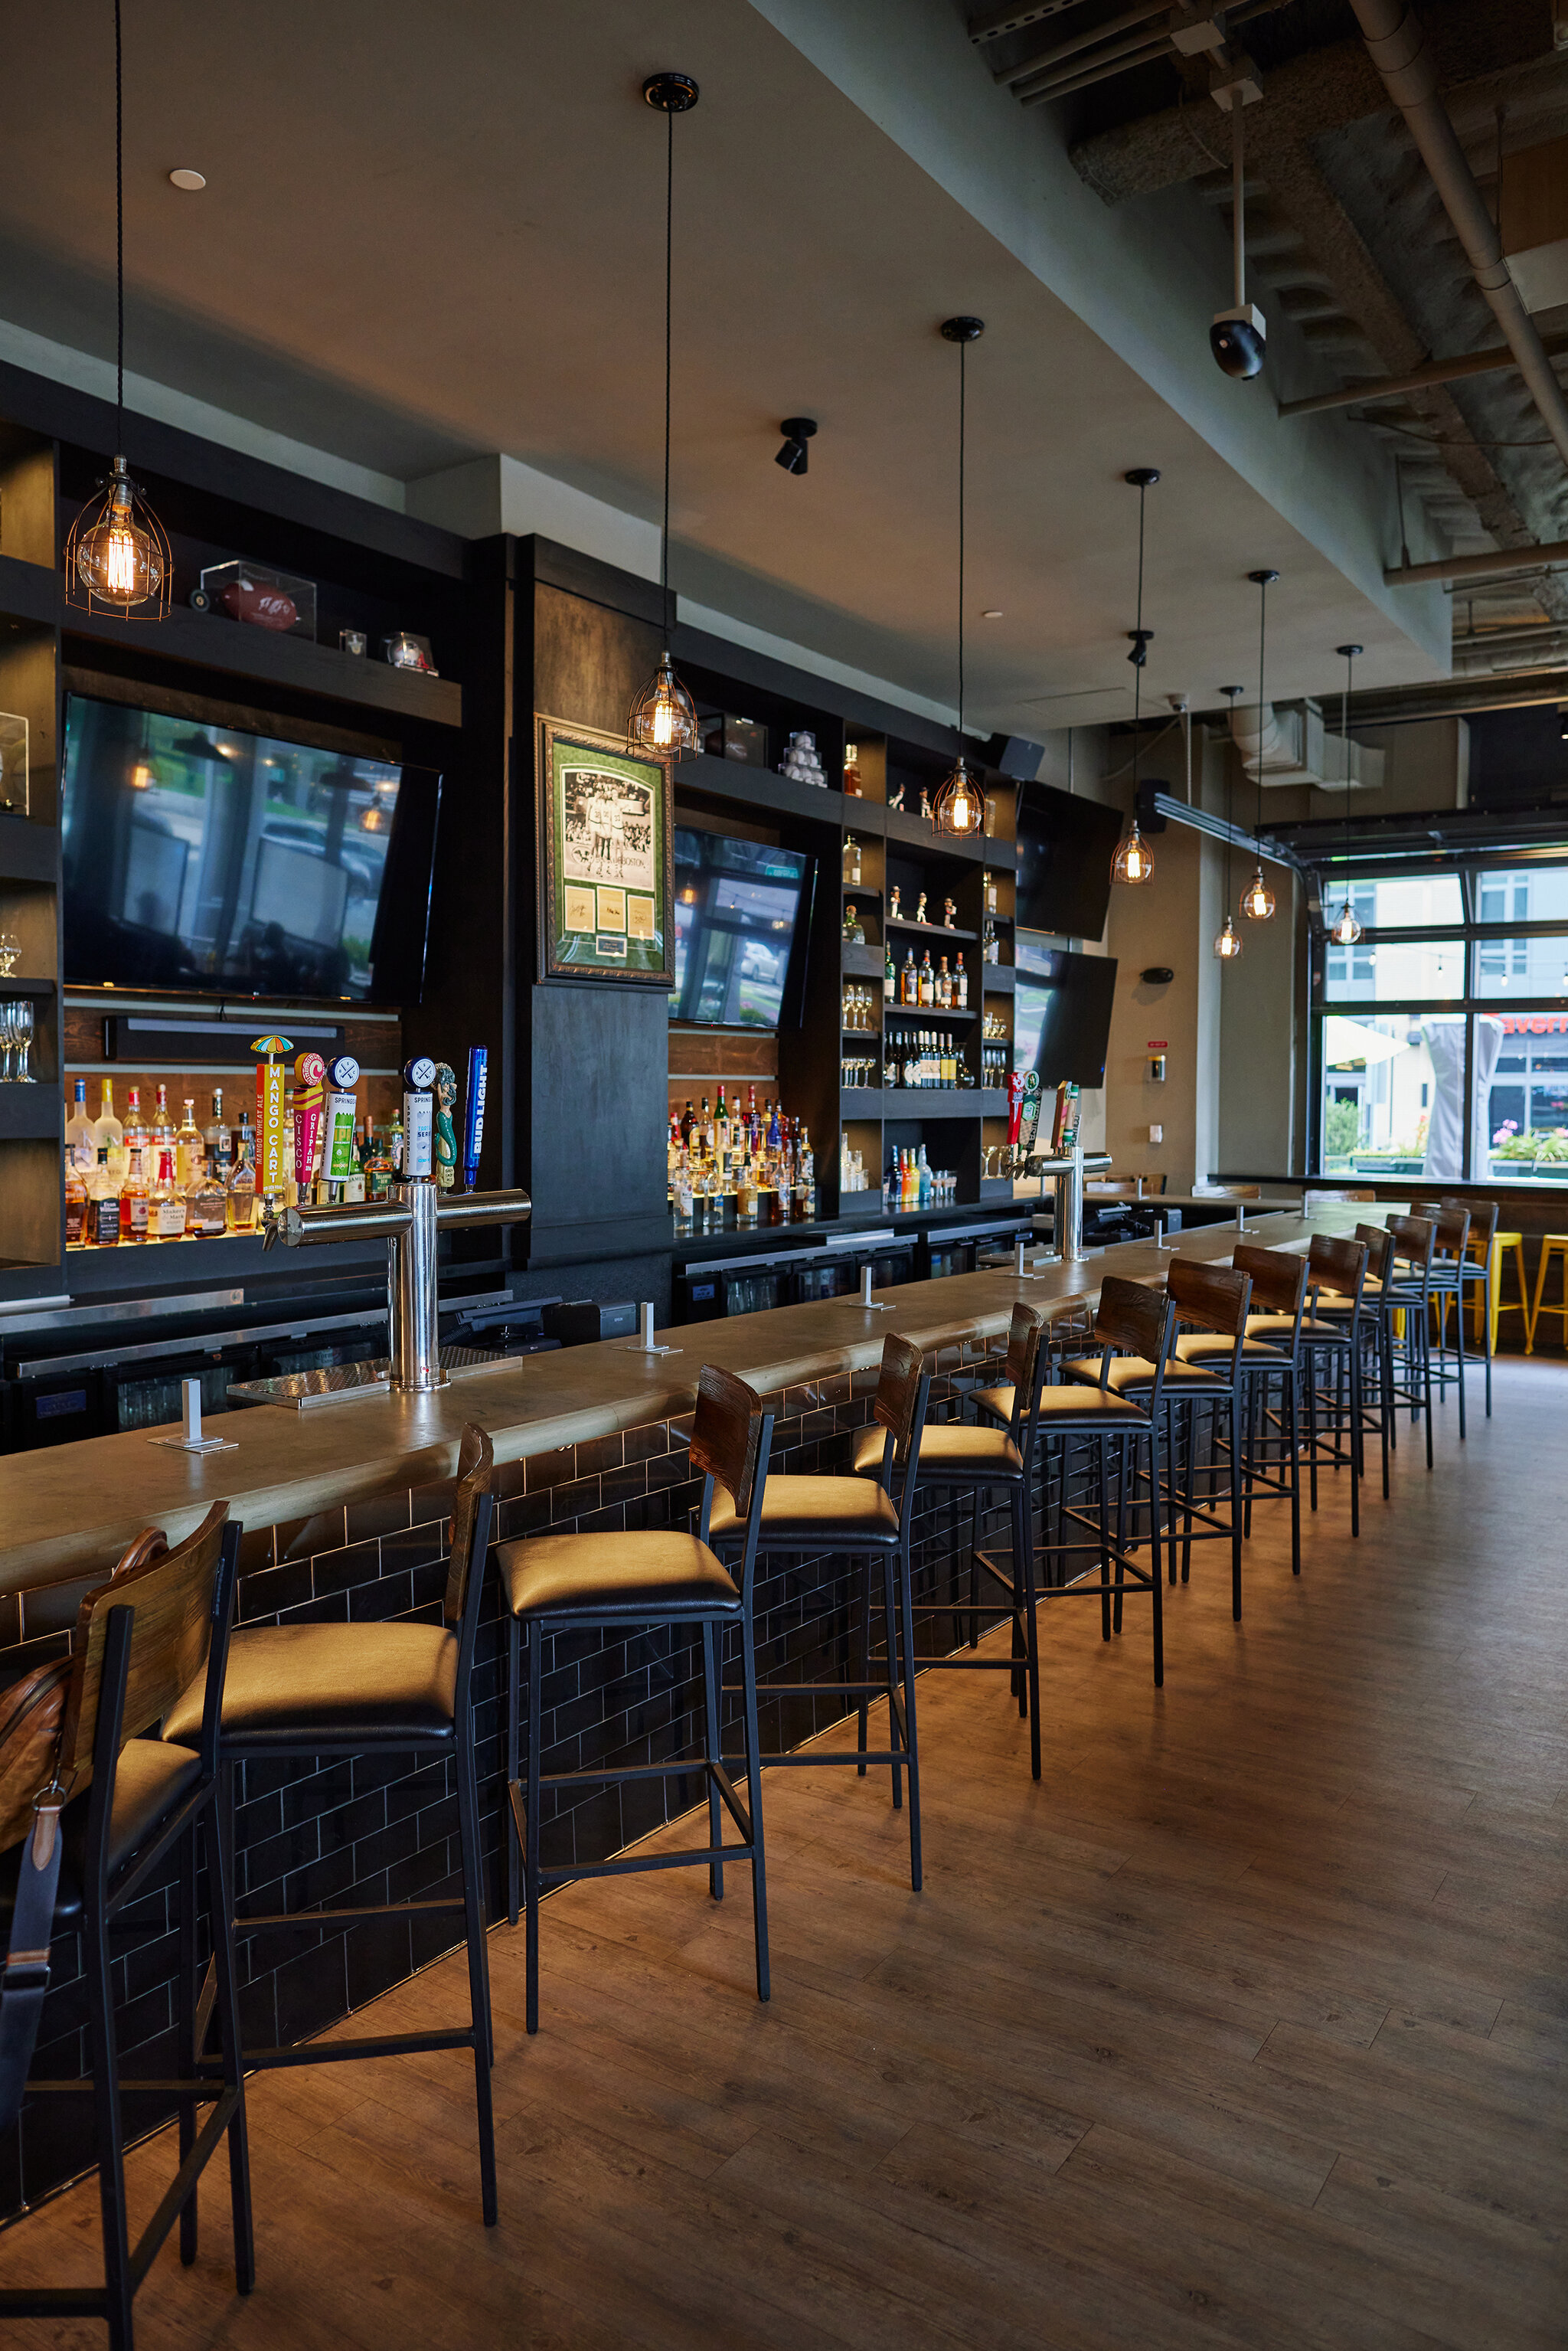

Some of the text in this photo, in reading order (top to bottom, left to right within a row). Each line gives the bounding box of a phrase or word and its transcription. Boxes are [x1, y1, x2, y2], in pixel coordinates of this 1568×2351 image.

[1483, 1013, 1568, 1035] avern
[268, 1067, 280, 1183] MANGO CART
[473, 1064, 488, 1154] BUD LIGHT
[306, 1113, 316, 1164] GRIPAH
[334, 1128, 351, 1142] IPA
